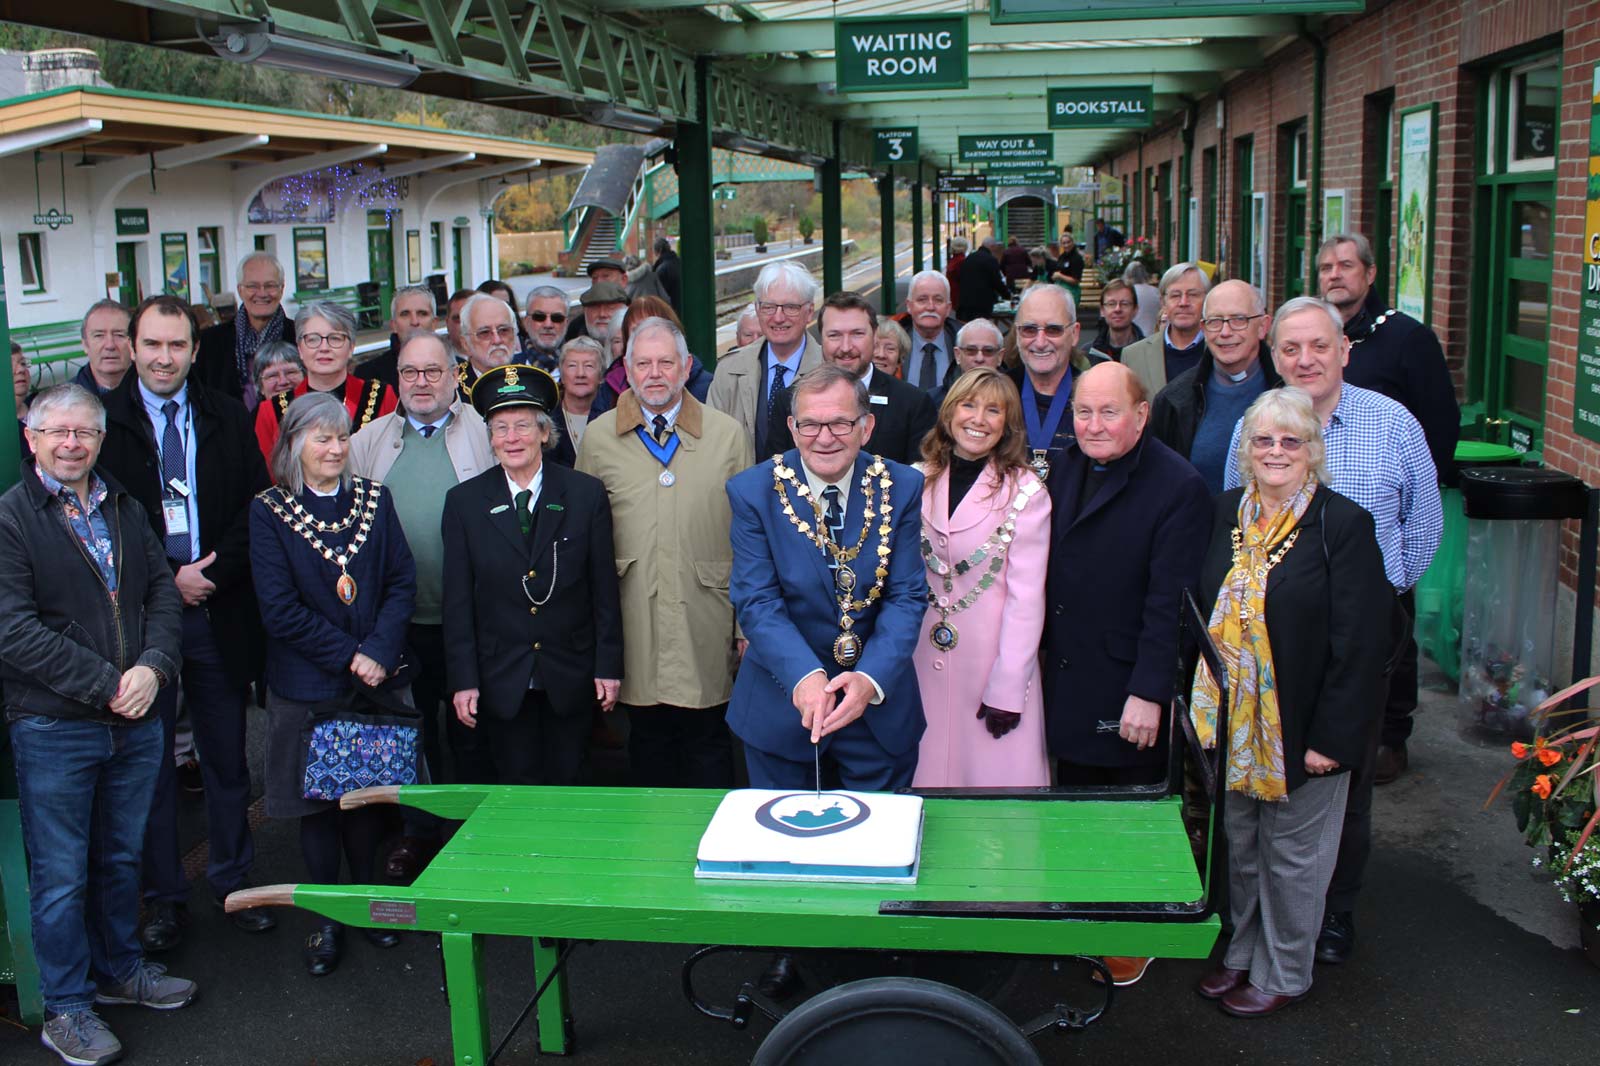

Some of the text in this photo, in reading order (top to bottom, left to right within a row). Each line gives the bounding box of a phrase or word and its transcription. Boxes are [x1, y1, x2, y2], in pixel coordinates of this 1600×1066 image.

[852, 32, 952, 53] WAITING
[867, 56, 937, 76] ROOM
[1056, 101, 1145, 115] BOOKSTALL
[889, 139, 904, 160] 3
[976, 138, 1035, 149] WAY OUT &
[964, 150, 1000, 158] DARTMOOR
[121, 216, 145, 225] MUSEUM
